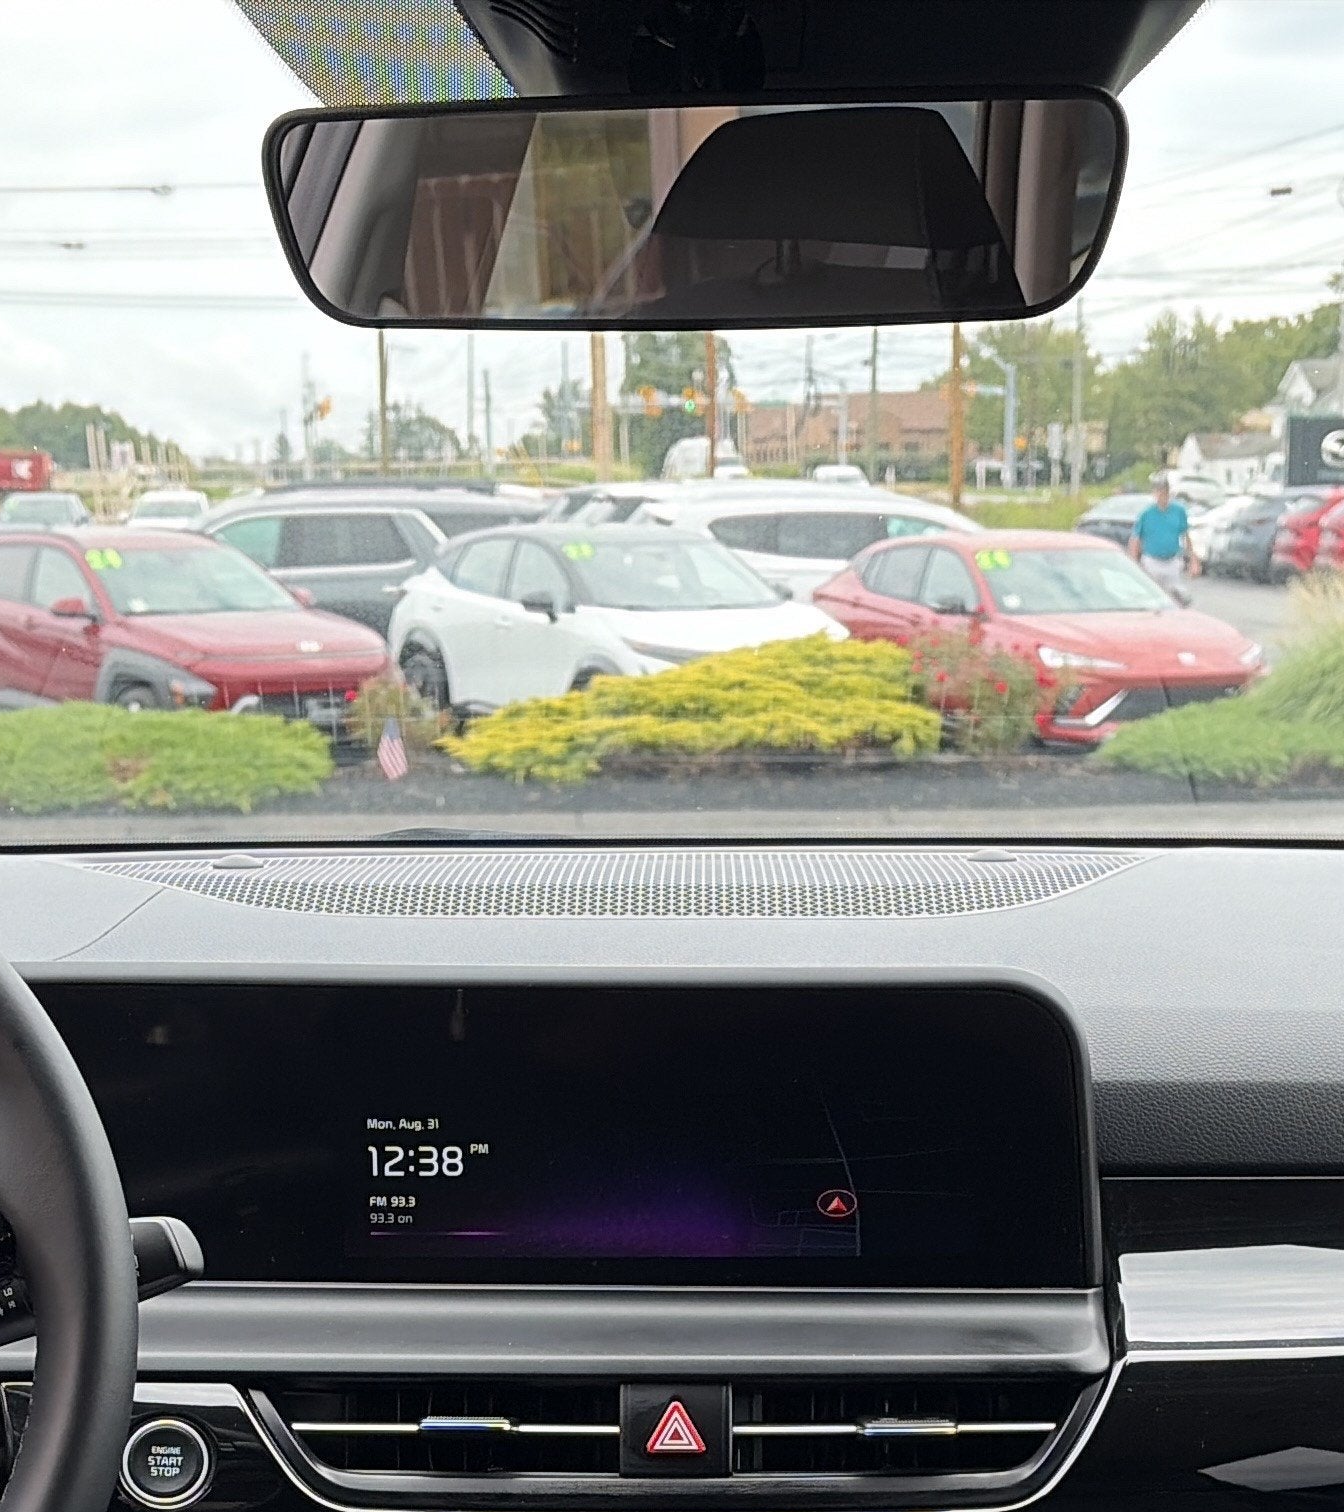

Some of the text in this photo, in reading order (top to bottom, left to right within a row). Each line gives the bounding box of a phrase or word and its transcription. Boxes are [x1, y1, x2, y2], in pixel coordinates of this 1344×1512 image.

[398, 1118, 425, 1132] Aug.
[427, 1118, 440, 1130] 31
[367, 1143, 489, 1177] 12:38 PM
[369, 1195, 416, 1208] FM 93.3
[369, 1212, 413, 1224] 93.3 on
[151, 1445, 181, 1455] ENGINE
[147, 1455, 184, 1467] START
[150, 1466, 180, 1477] STOP
